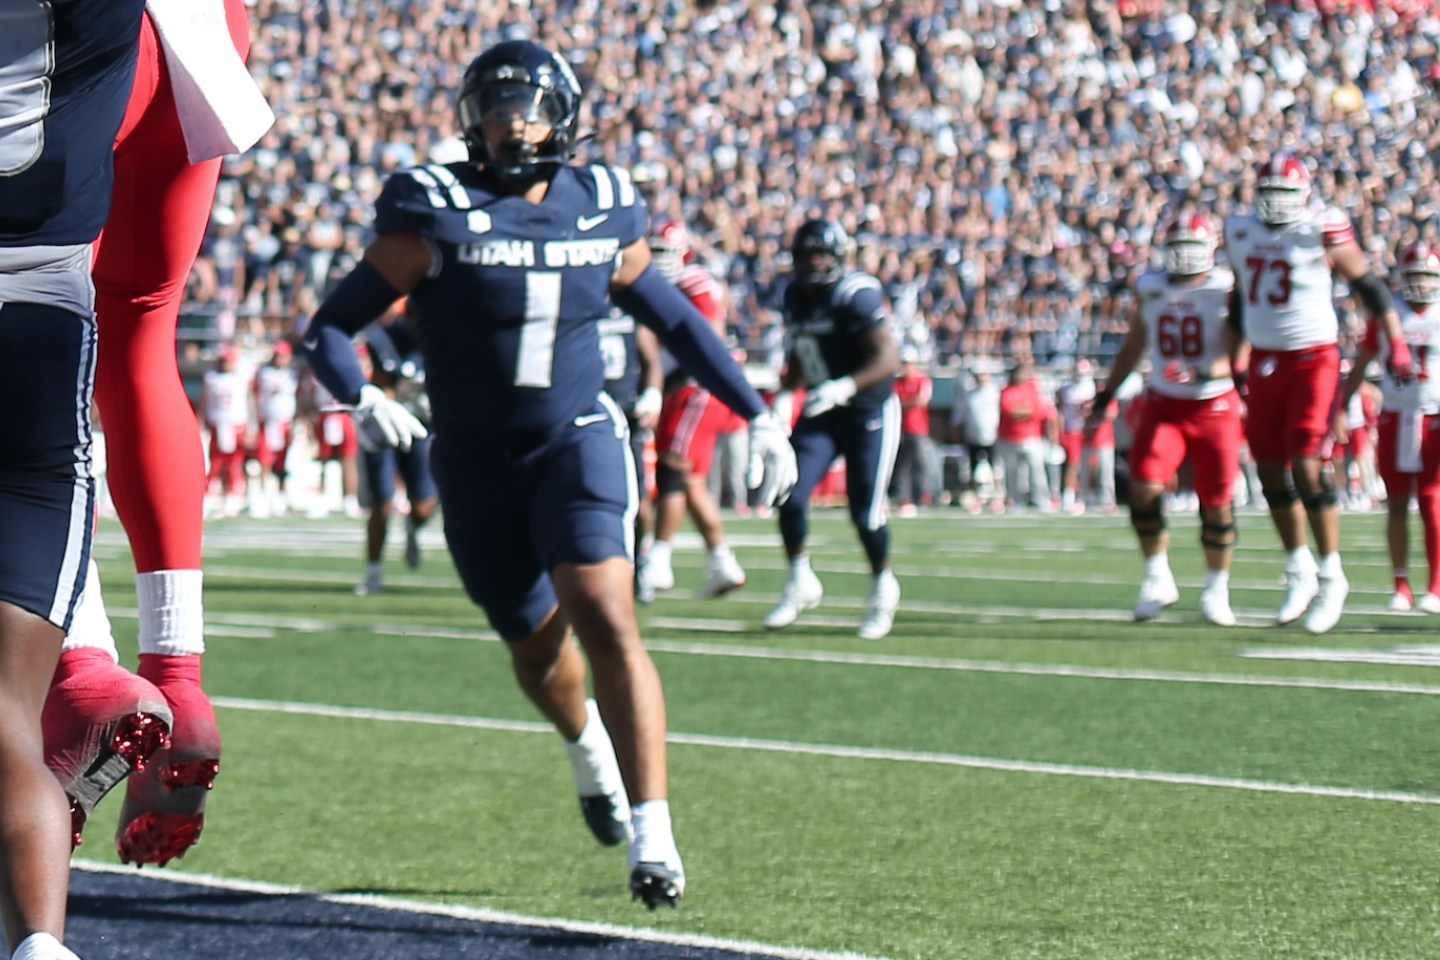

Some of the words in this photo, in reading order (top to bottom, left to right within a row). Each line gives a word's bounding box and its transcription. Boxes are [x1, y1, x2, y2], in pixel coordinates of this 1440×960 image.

[457, 240, 536, 267] UTAH
[1245, 256, 1293, 308] 73
[514, 271, 561, 388] 1
[1157, 315, 1204, 359] 68
